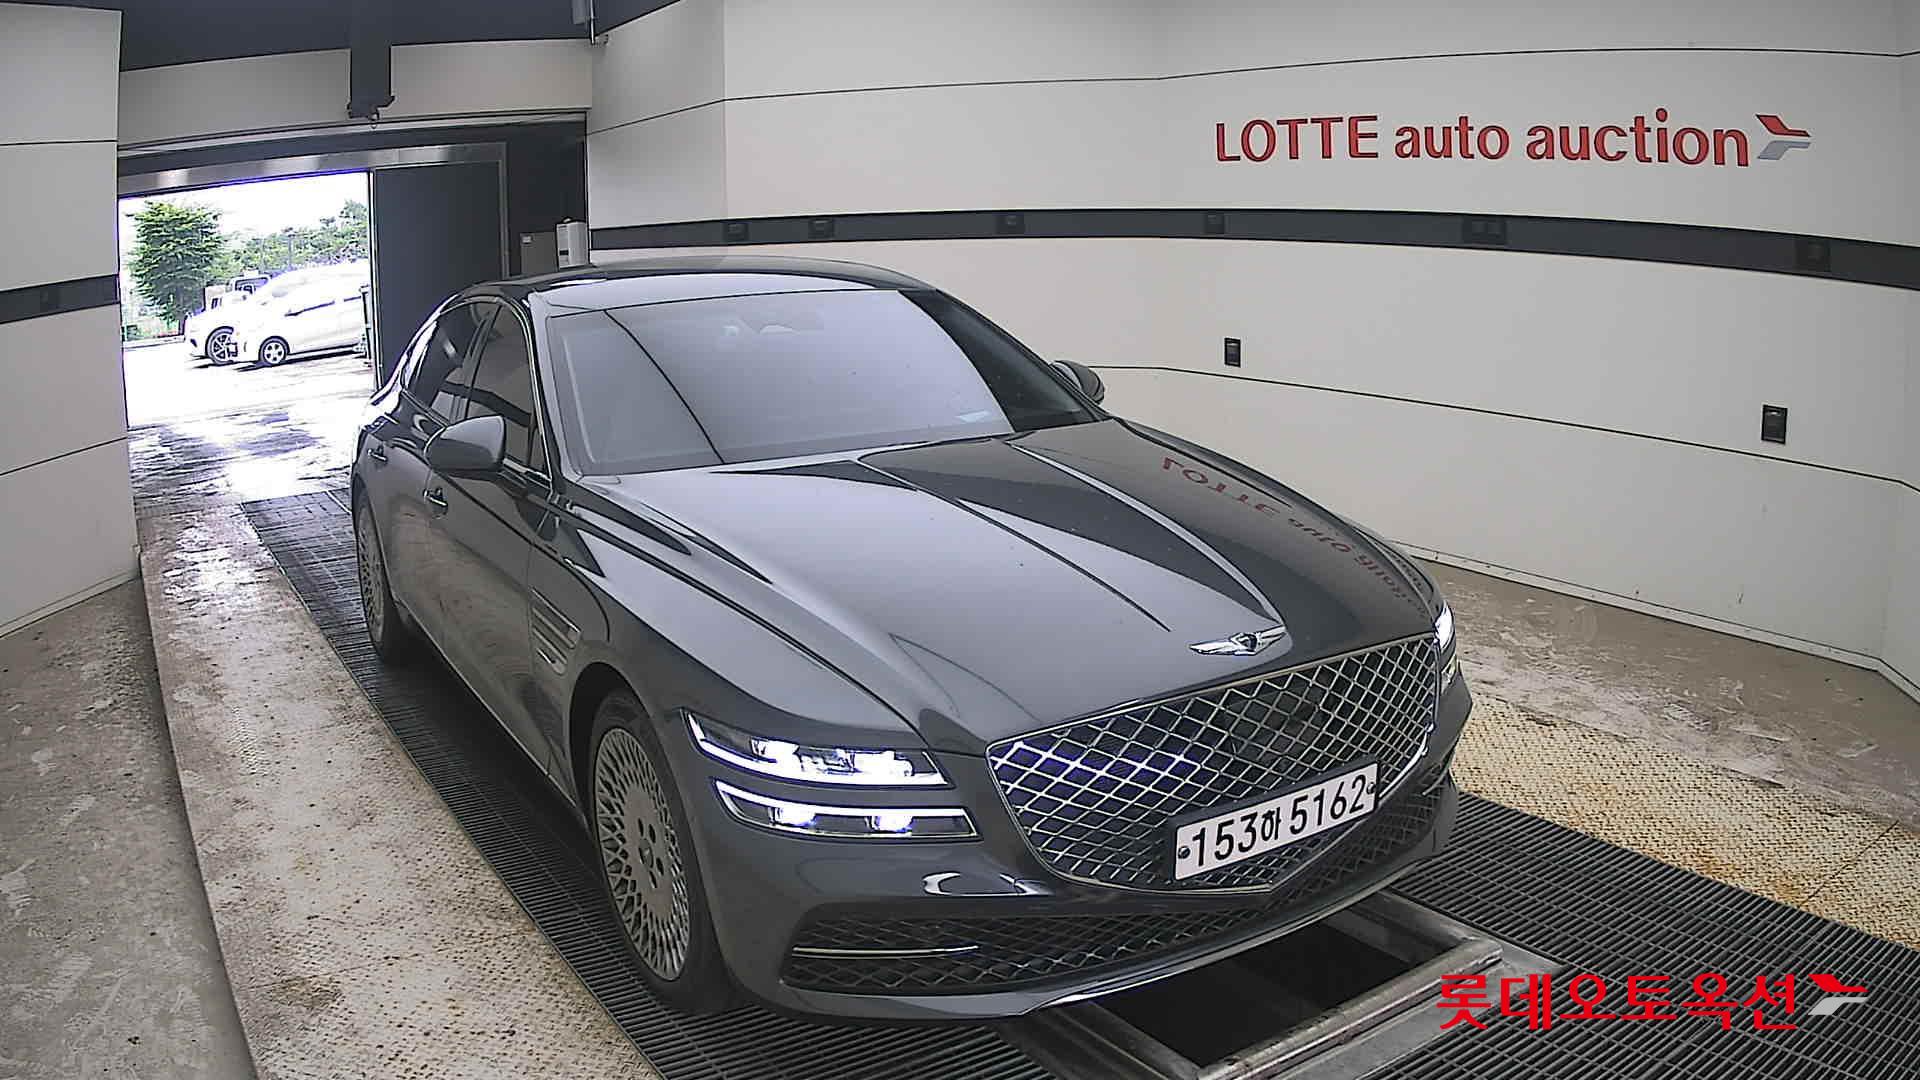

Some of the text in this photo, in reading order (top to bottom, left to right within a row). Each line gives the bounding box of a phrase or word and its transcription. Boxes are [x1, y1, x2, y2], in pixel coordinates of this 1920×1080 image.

[1216, 107, 1750, 167] LOTTE auto auction
